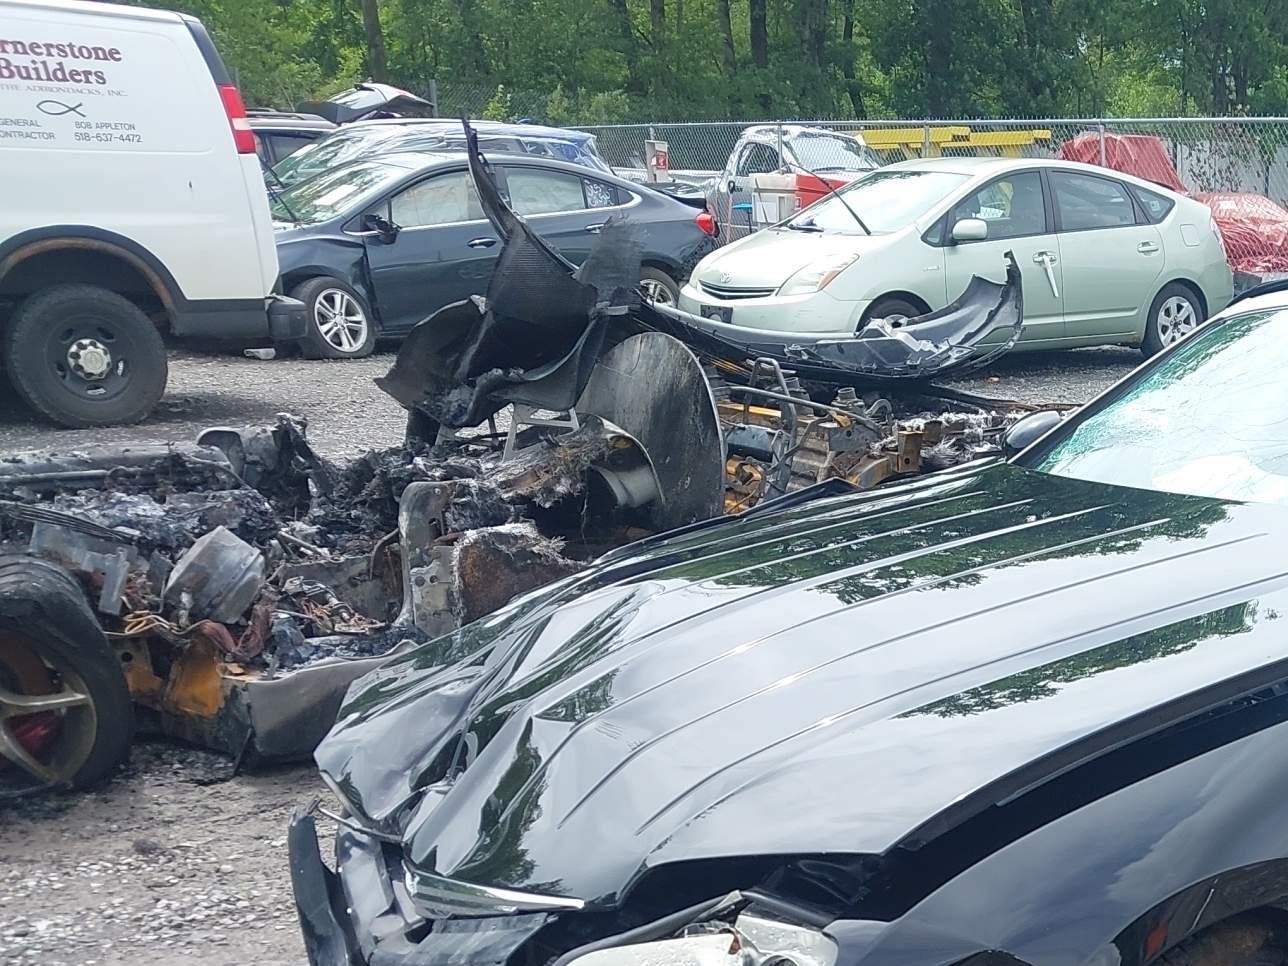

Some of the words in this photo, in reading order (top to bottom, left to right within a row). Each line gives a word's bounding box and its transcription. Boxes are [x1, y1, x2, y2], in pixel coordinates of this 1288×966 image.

[0, 57, 107, 85] Builders
[75, 121, 92, 130] BOB
[95, 122, 136, 131] APPLETON
[74, 132, 143, 143] 518-637-4472
